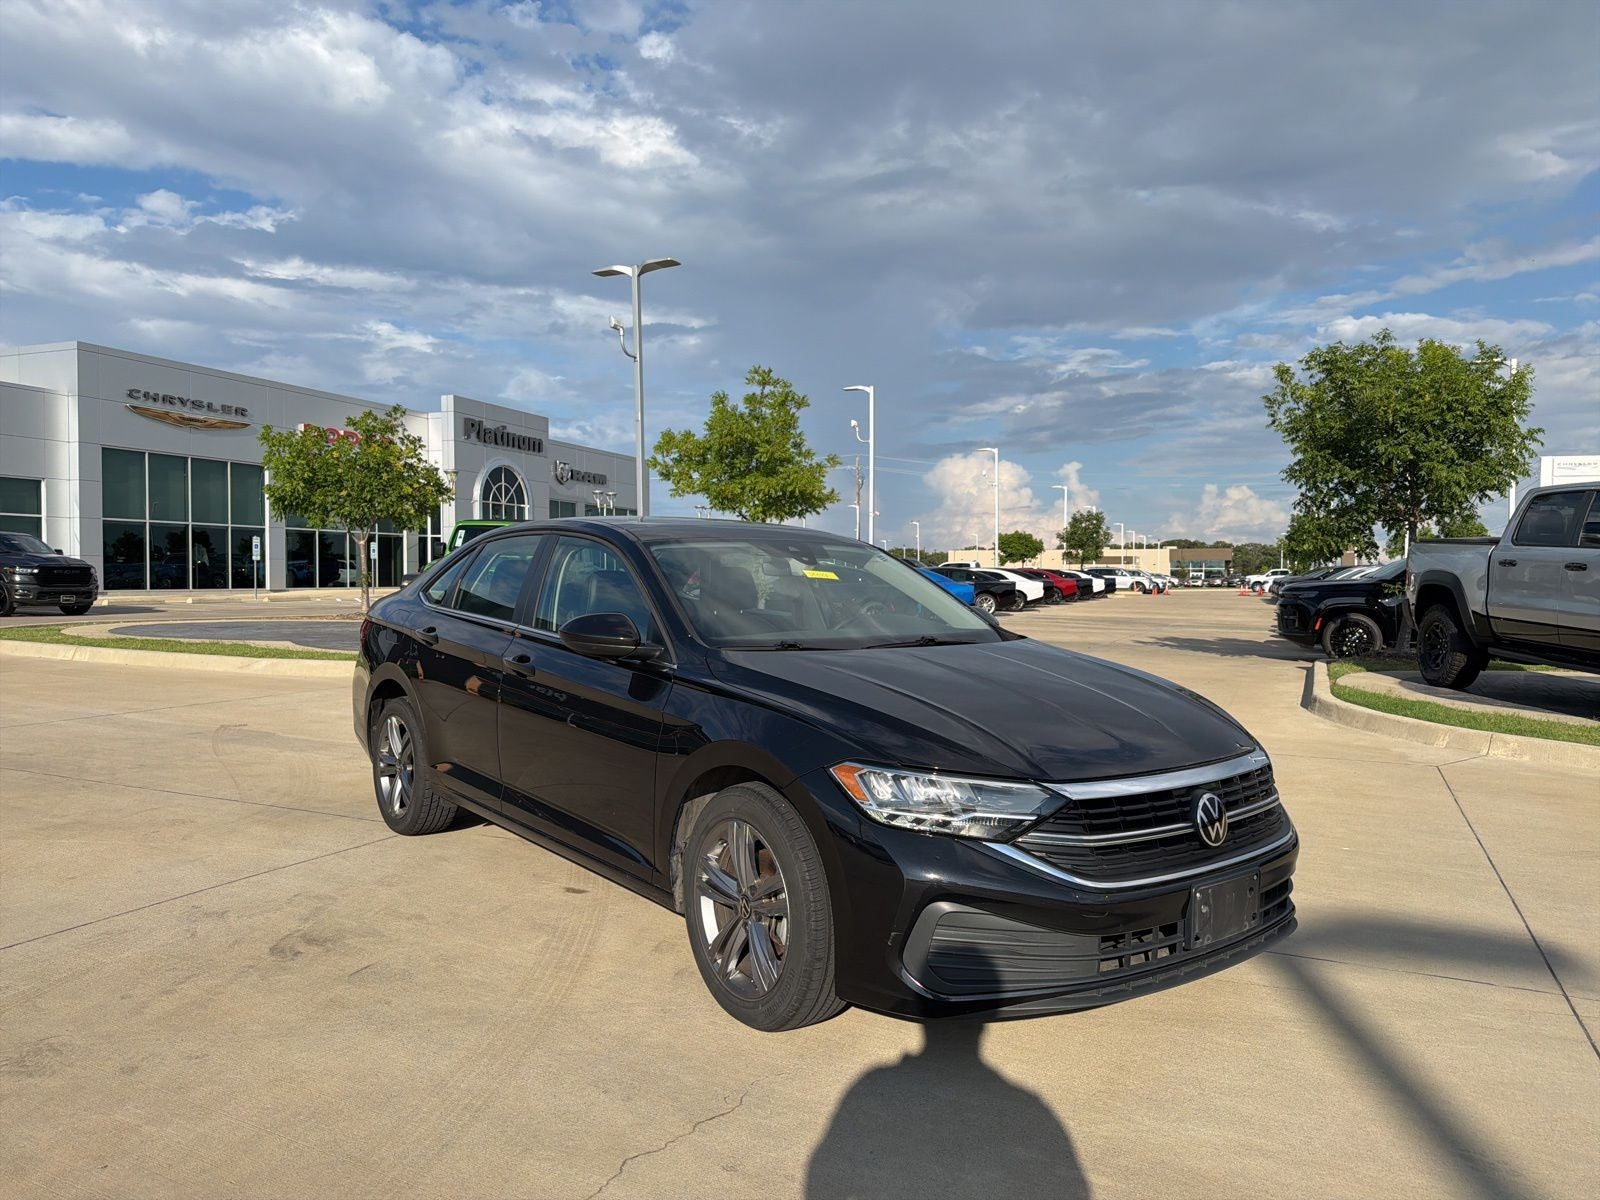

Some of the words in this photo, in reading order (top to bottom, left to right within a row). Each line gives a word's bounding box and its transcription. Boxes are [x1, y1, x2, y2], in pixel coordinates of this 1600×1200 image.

[127, 388, 249, 417] CHRYSLER
[464, 417, 544, 453] Platinum
[571, 469, 607, 485] RAM
